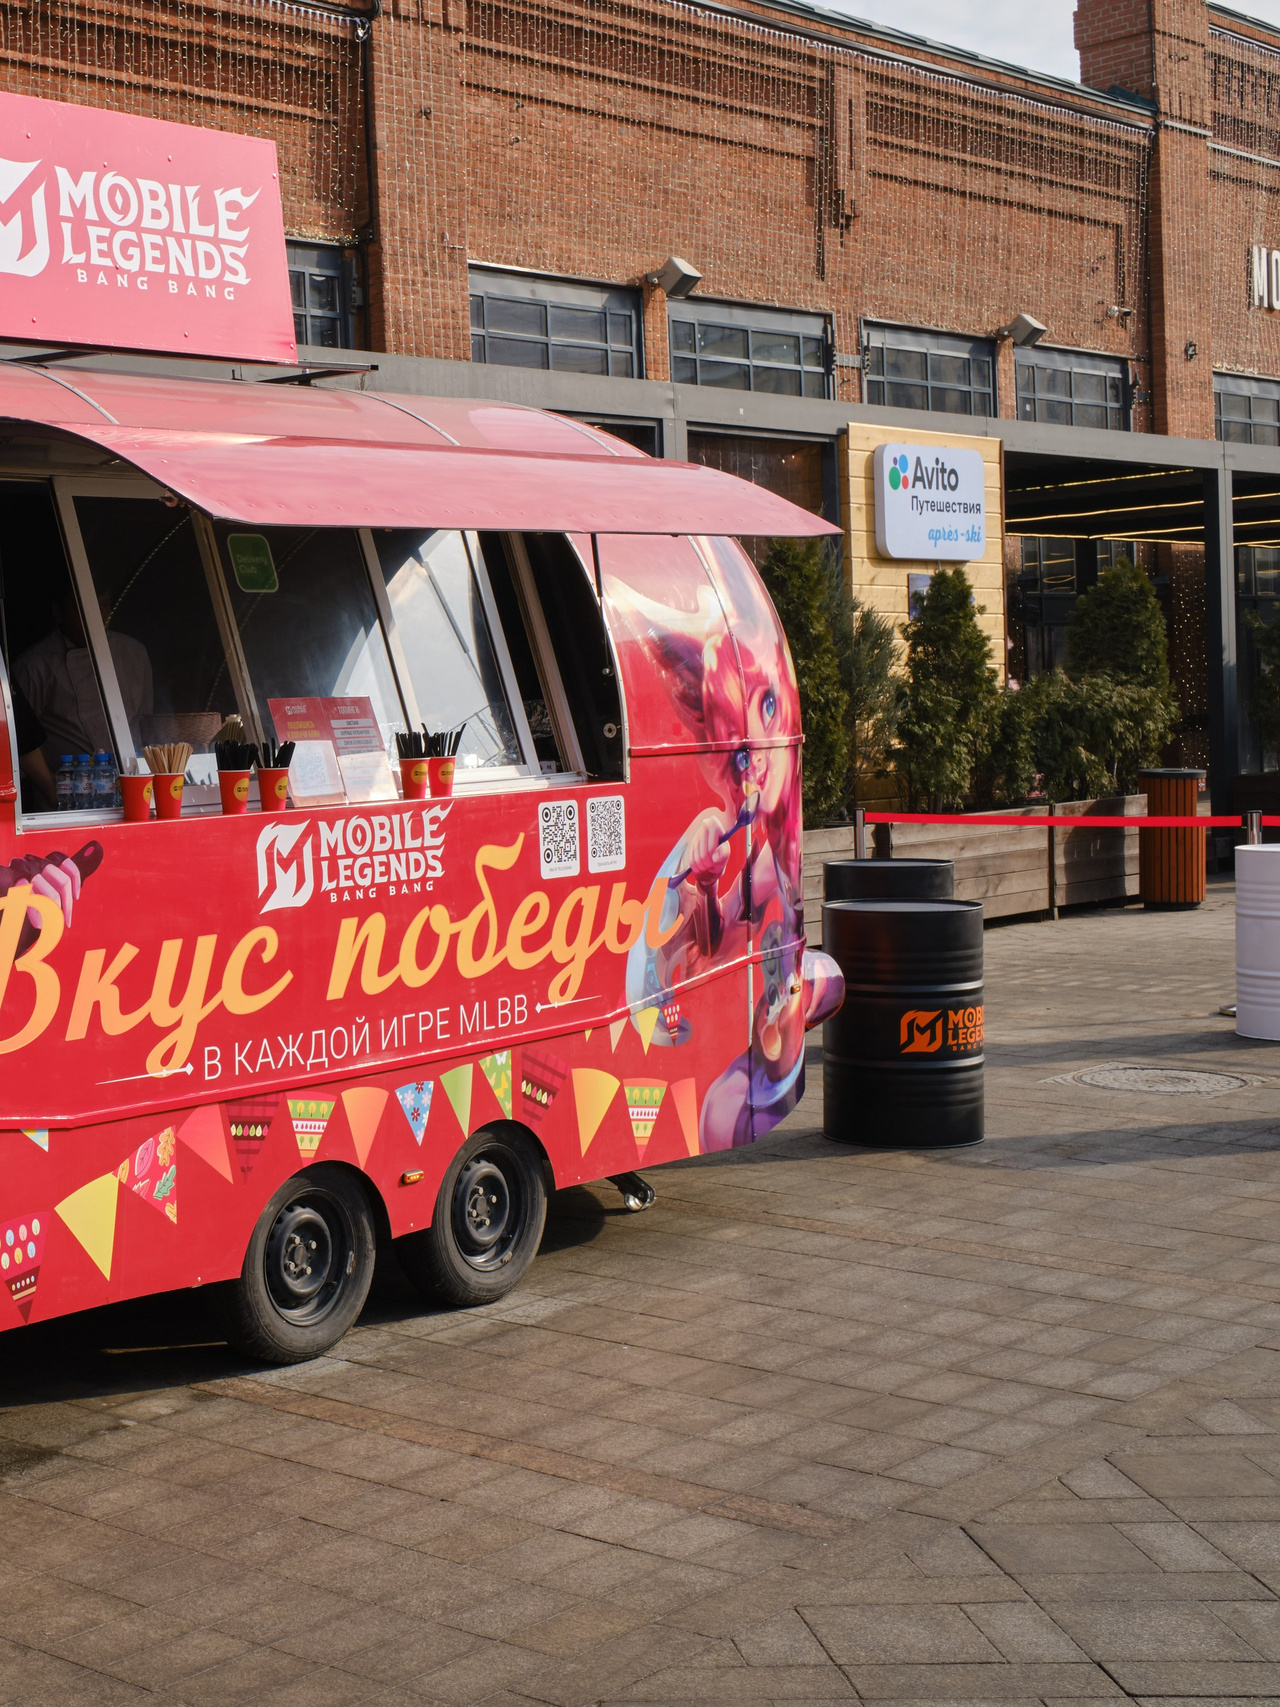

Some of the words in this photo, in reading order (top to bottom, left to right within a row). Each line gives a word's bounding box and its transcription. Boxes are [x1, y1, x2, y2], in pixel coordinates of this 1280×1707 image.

[54, 165, 262, 242] MOBILE
[61, 222, 251, 286] LEGENDS
[77, 268, 149, 291] BANG
[168, 280, 235, 301] BANG
[912, 456, 959, 492] Avito
[911, 495, 981, 515] Путешествия
[236, 554, 268, 566] Delivery
[239, 565, 258, 574] Club
[318, 800, 455, 857] MOBILE
[320, 844, 446, 893] LEGENDS
[330, 887, 377, 903] BANG
[389, 880, 434, 896] BANG
[326, 831, 685, 1004] победы
[204, 1046, 222, 1080] В
[234, 1015, 370, 1076] КАЖДОЙ
[381, 1007, 451, 1050] ИГРЕ
[459, 994, 529, 1035] MLBB
